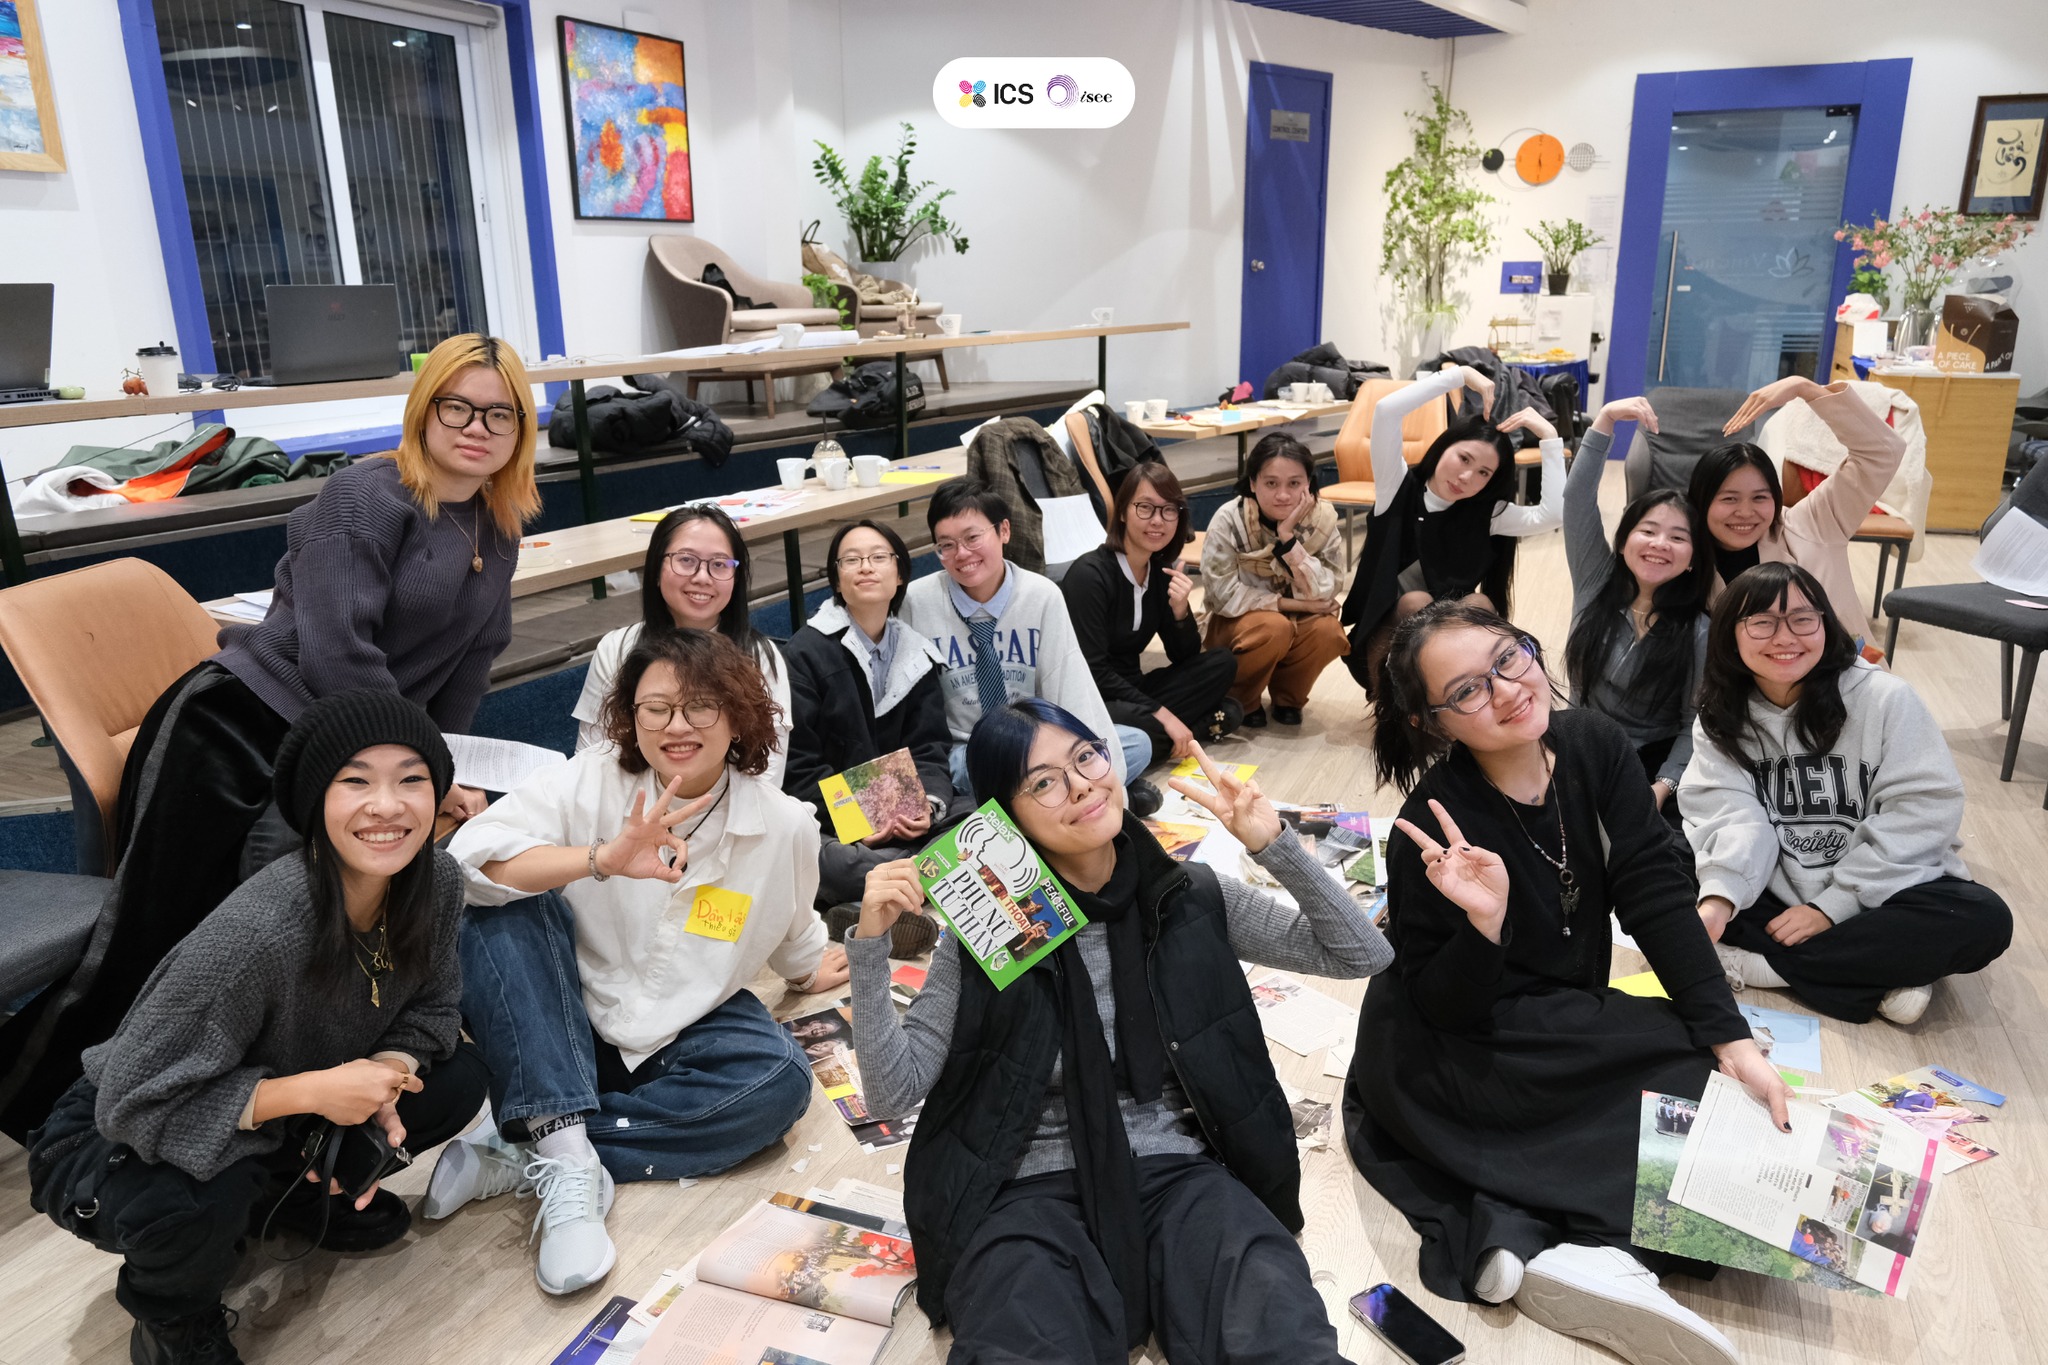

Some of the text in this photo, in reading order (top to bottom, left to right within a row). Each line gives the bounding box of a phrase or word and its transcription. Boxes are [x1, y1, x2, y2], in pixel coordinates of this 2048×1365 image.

[1938, 361, 1977, 370] OF CAKE
[1946, 352, 1971, 361] PIECE
[984, 809, 1015, 842] Relax
[1784, 827, 1848, 860] Society
[1041, 879, 1075, 927] PEACEFUL
